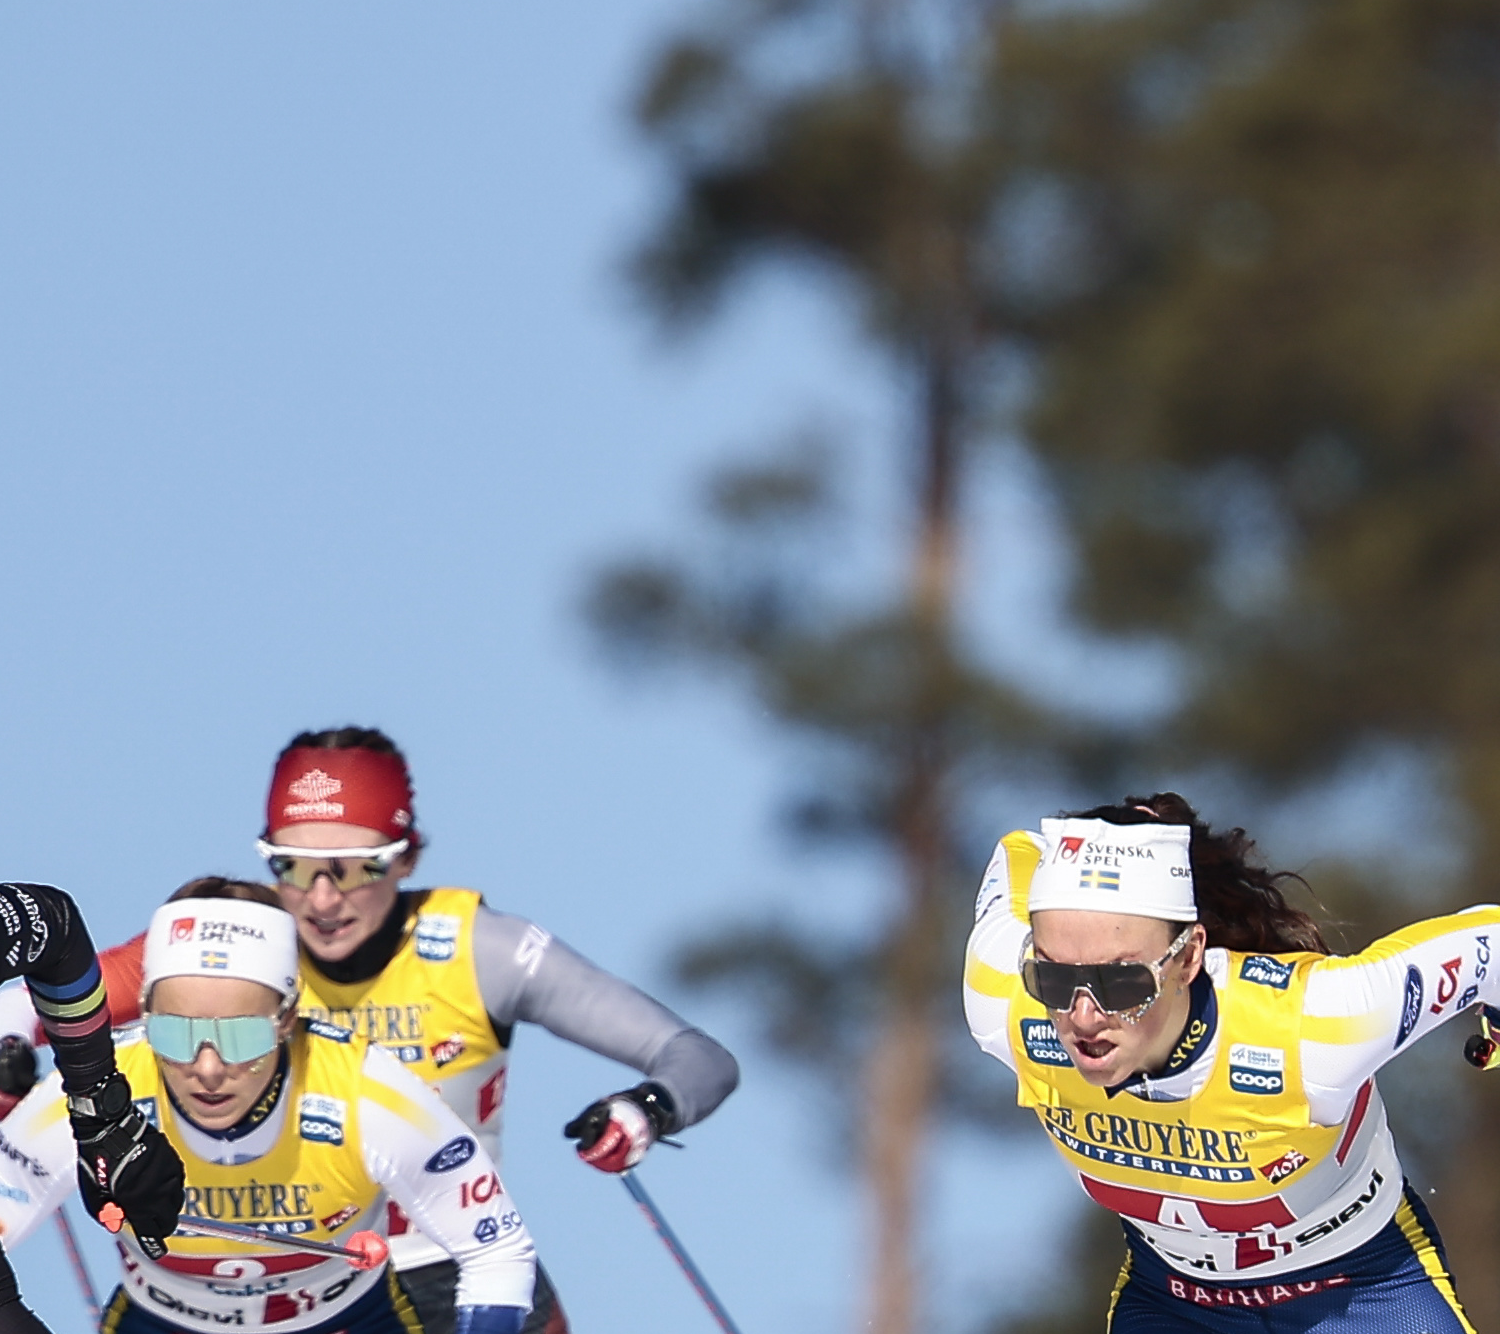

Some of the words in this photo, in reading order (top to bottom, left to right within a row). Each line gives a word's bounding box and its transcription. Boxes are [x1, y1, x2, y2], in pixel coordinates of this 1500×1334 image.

[1083, 855, 1123, 868] SPEL
[1085, 842, 1155, 861] SVENSKA
[199, 930, 236, 945] SPEL
[201, 920, 267, 941] SVENSKA
[1475, 934, 1491, 981] SCA
[1027, 1025, 1059, 1041] MiN
[1169, 1019, 1208, 1068] LYKO
[1033, 1048, 1069, 1062] coop
[1231, 1071, 1282, 1090] coop
[1085, 1110, 1250, 1163] GRUYÈRE
[1053, 1126, 1244, 1181] SWITZERLAND
[185, 1178, 315, 1219] RUYÈRE
